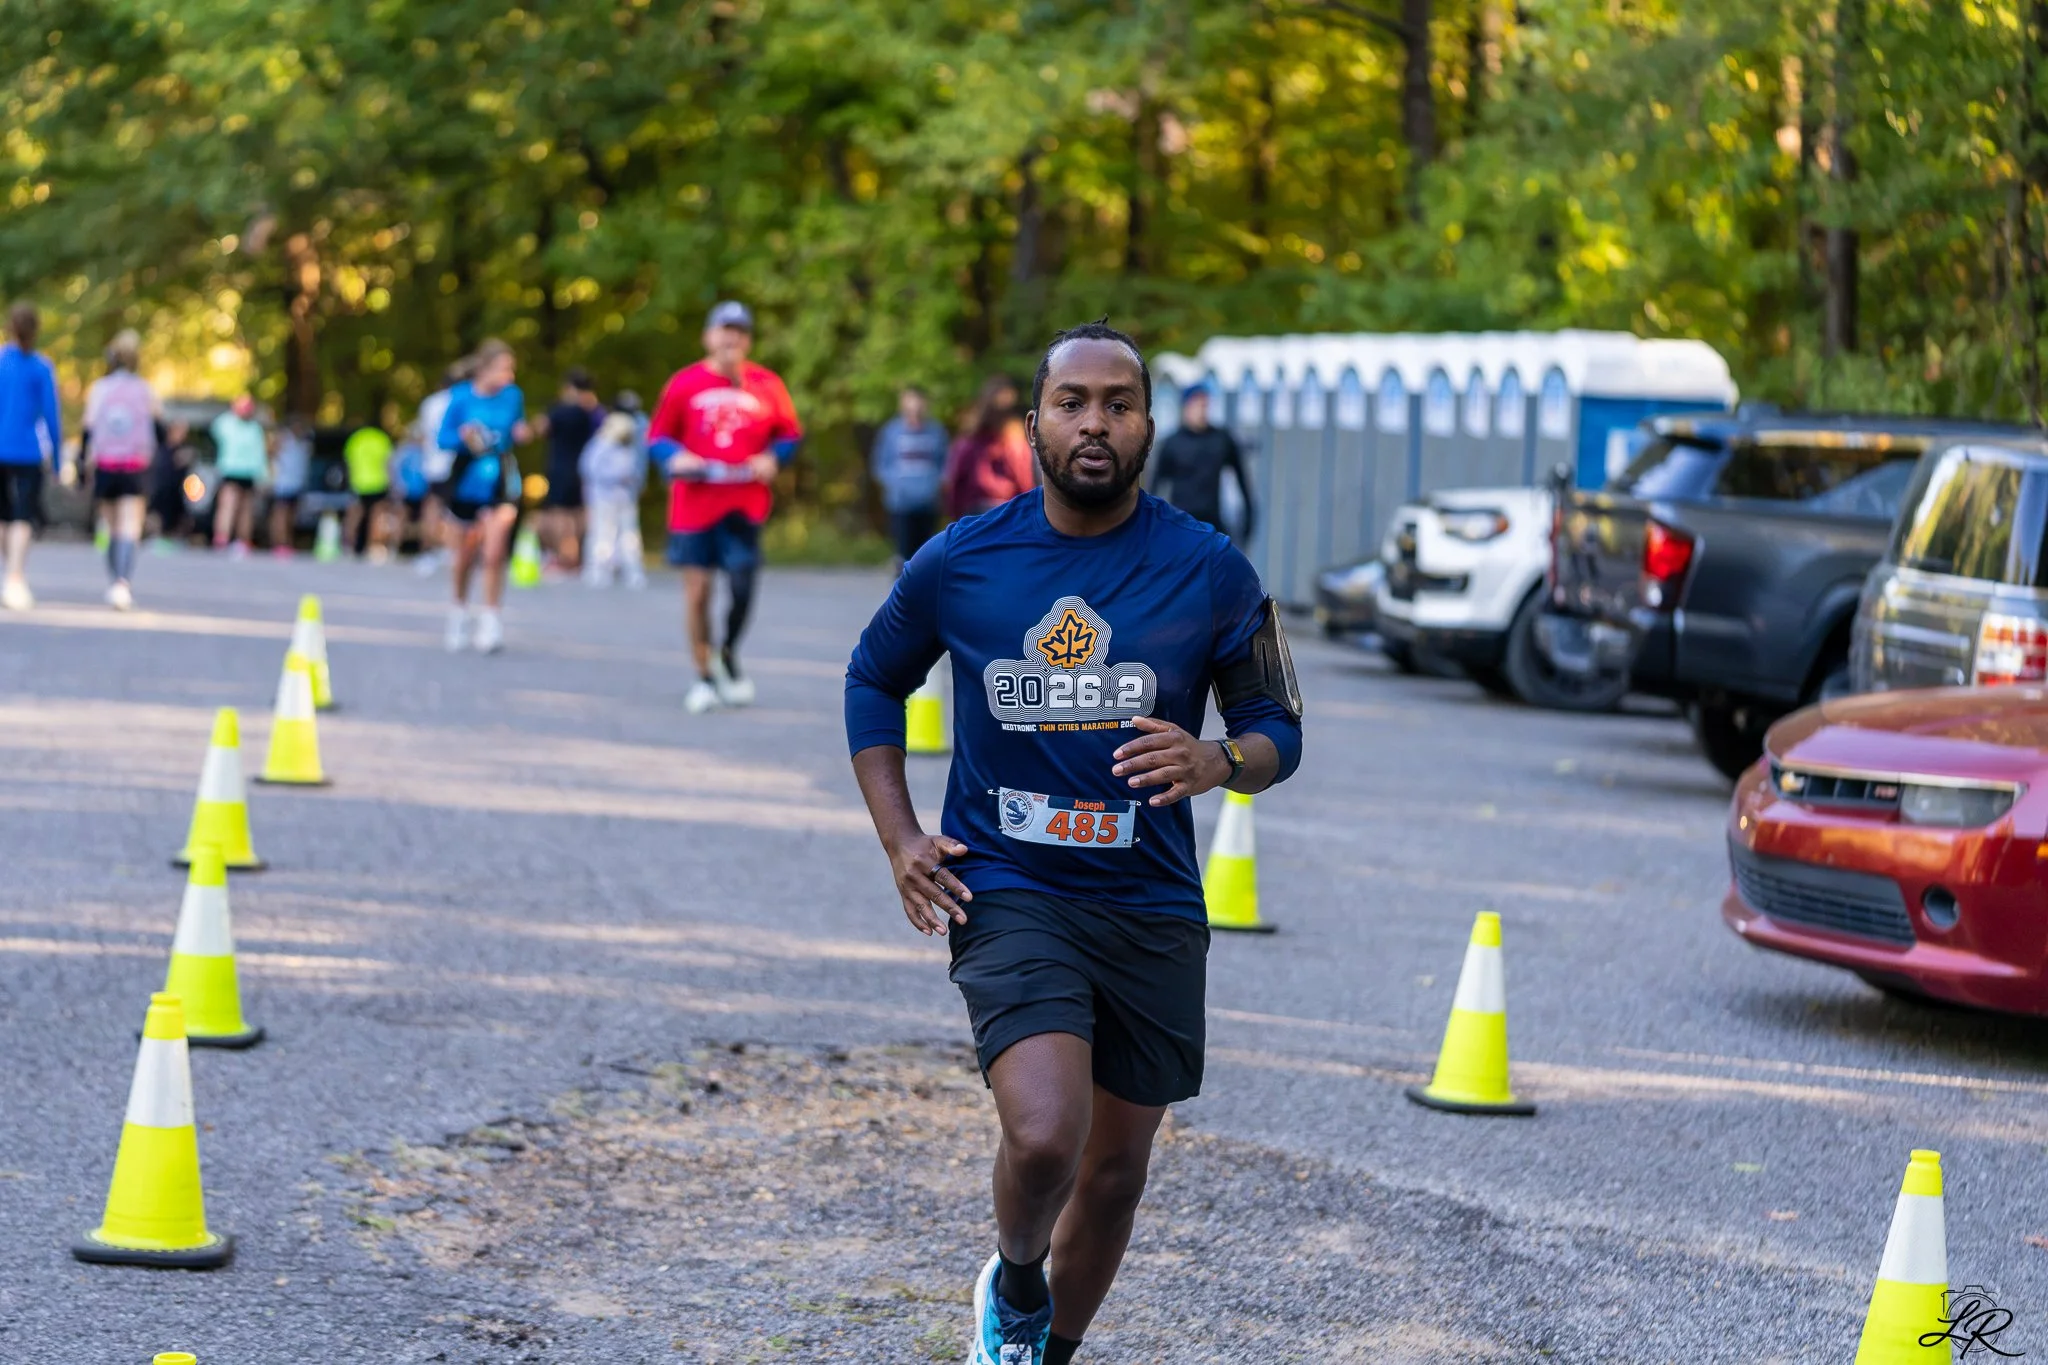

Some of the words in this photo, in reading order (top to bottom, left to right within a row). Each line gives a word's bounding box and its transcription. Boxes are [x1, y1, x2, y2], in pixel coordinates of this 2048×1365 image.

[994, 673, 1144, 708] 2026.2
[1039, 724, 1056, 732] TWIN
[1058, 723, 1079, 731] CITIES
[1081, 721, 1119, 731] MARATHON
[1120, 720, 1136, 729] 202
[1073, 799, 1105, 812] Joseph
[1045, 811, 1119, 844] 485
